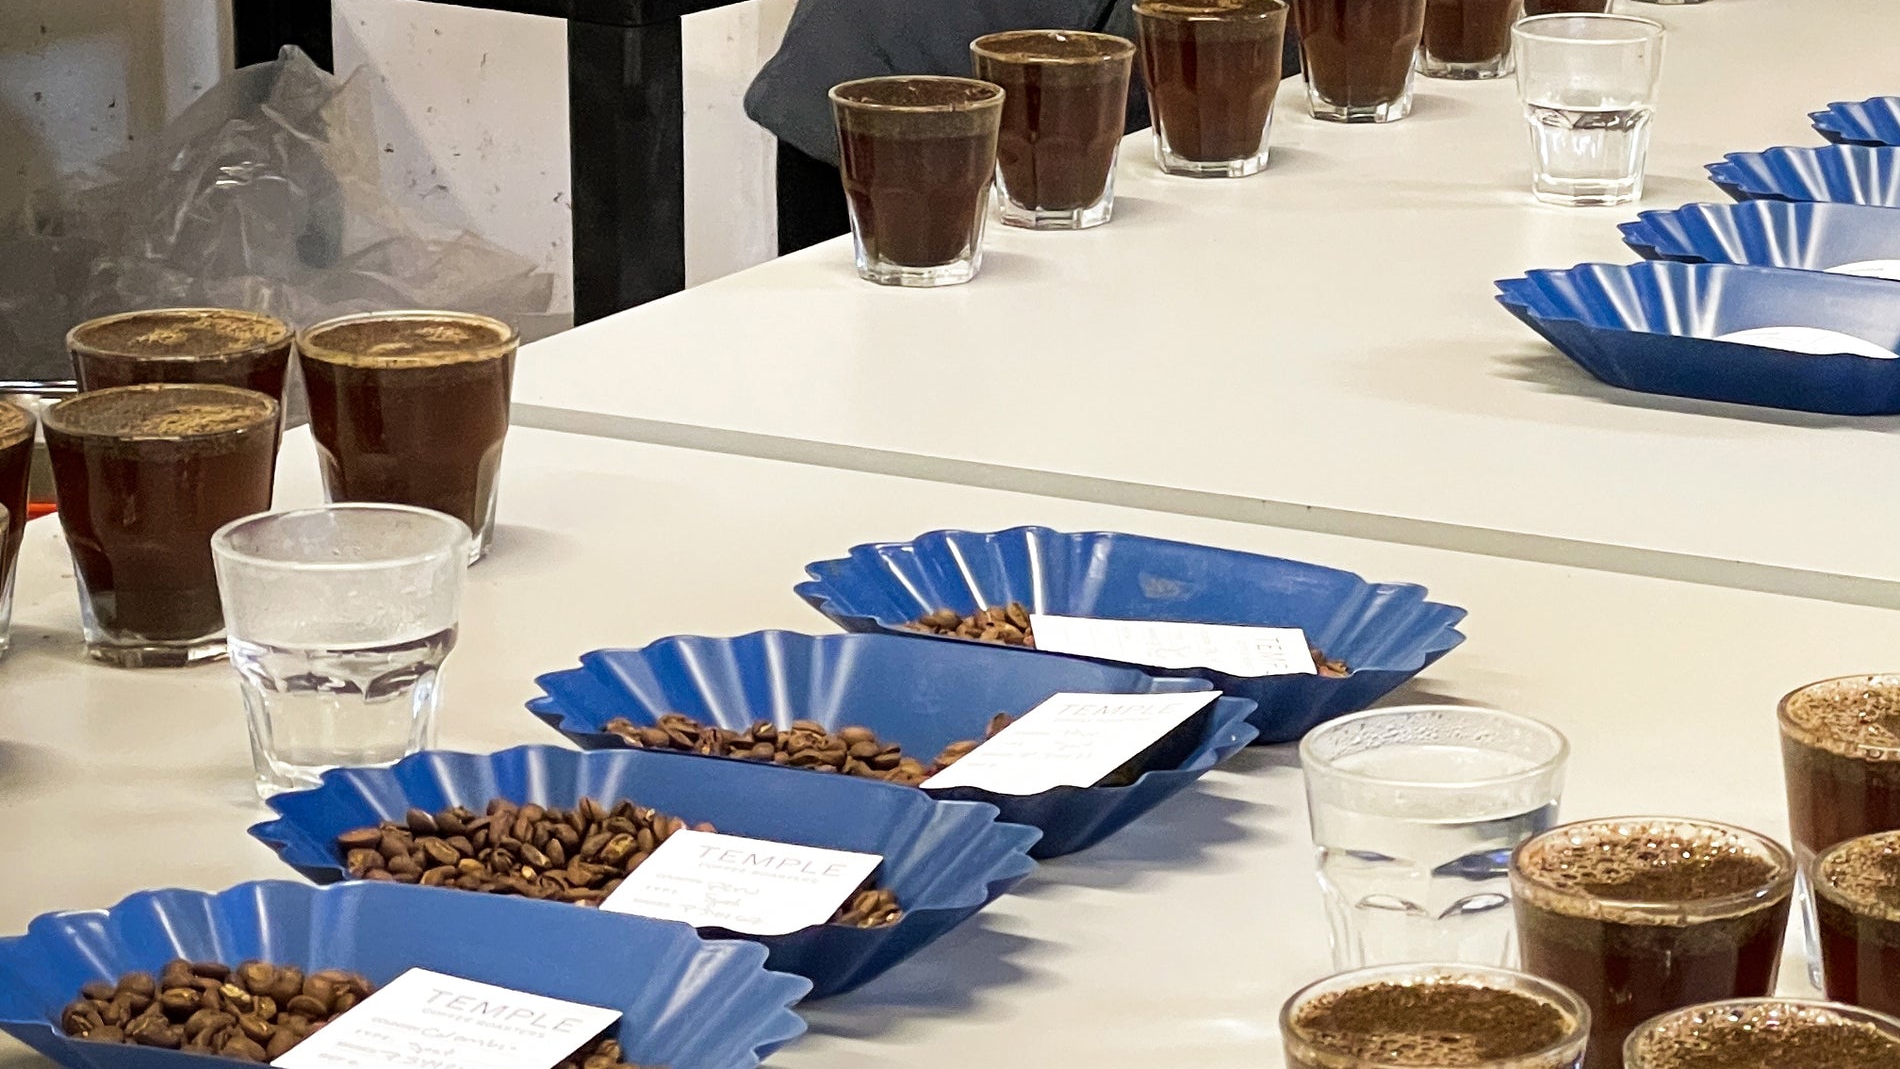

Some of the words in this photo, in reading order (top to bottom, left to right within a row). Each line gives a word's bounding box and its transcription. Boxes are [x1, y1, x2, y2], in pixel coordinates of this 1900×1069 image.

[1056, 703, 1184, 716] TEMPLE
[698, 844, 848, 877] TEMPLE
[426, 988, 583, 1034] TEMPLE
